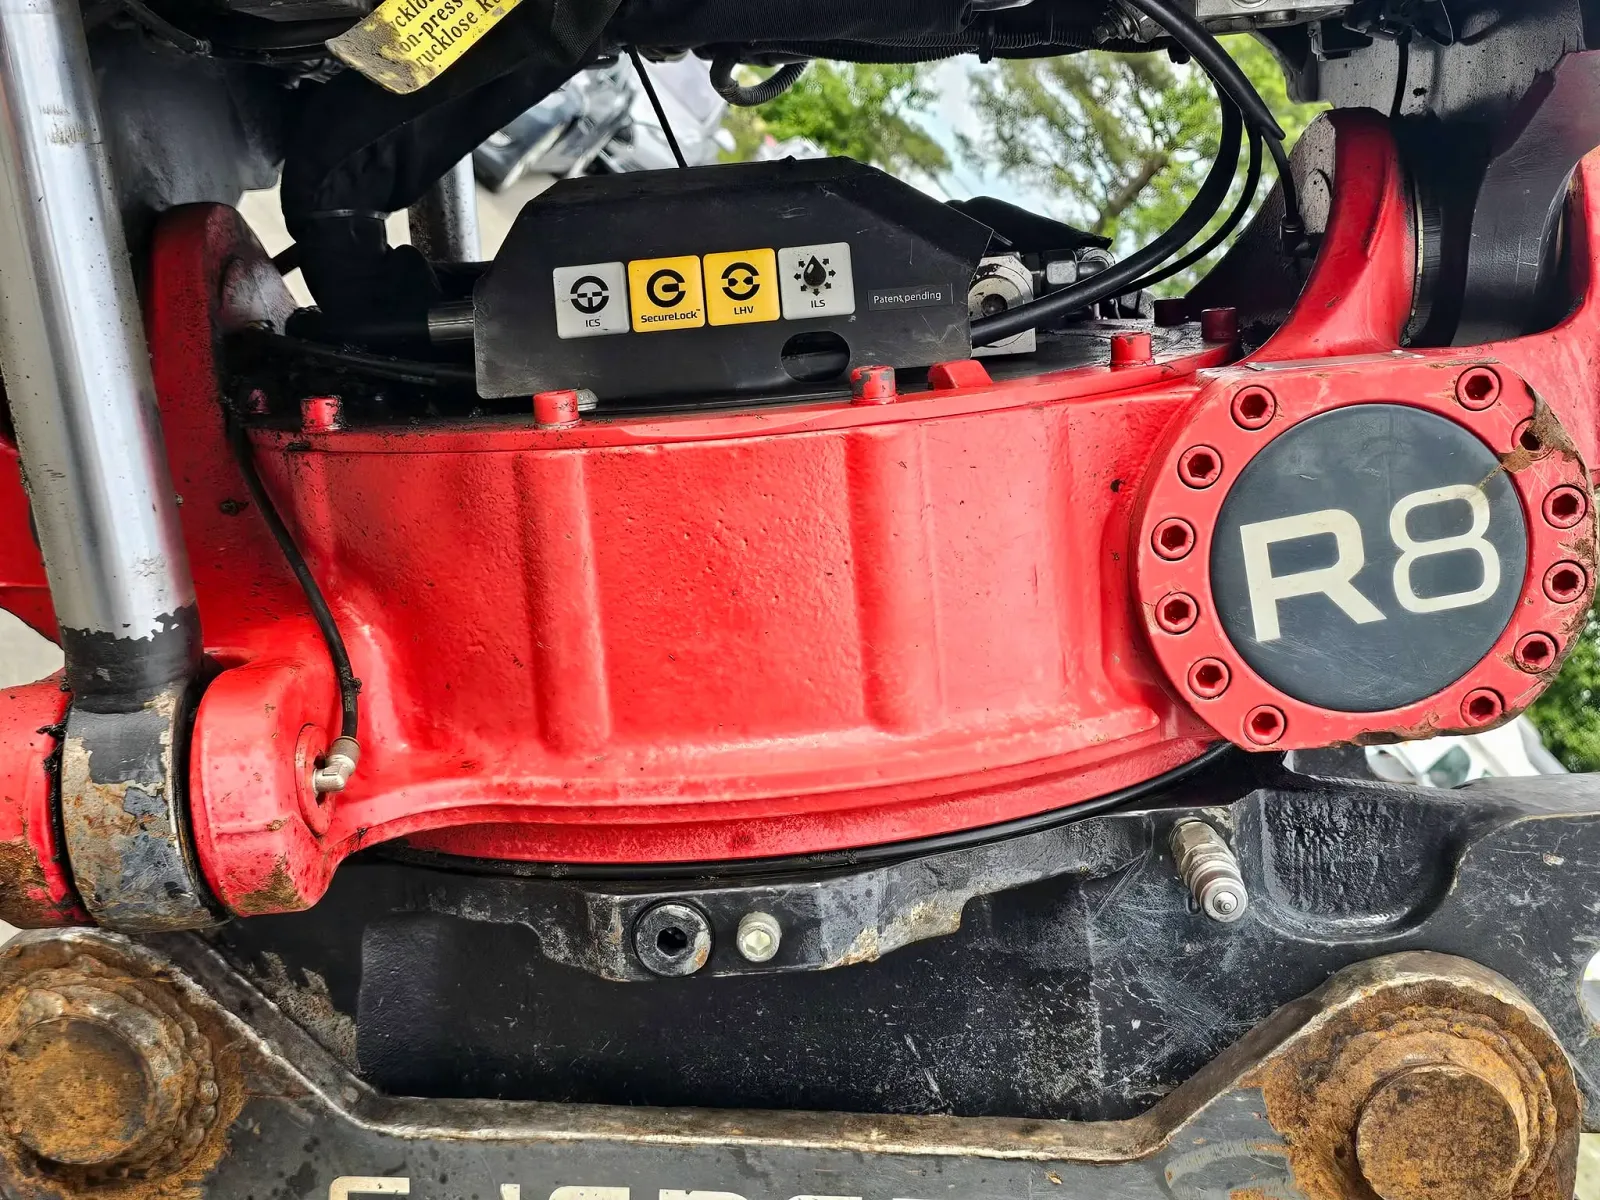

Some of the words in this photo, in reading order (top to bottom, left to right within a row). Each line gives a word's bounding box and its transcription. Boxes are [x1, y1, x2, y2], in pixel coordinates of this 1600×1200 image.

[397, 0, 463, 54] on-press
[873, 294, 904, 304] Patent
[904, 291, 942, 303] pending
[810, 300, 826, 308] ILS
[733, 306, 754, 315] LHV
[585, 318, 601, 328] ICS
[1239, 484, 1501, 642] R8
